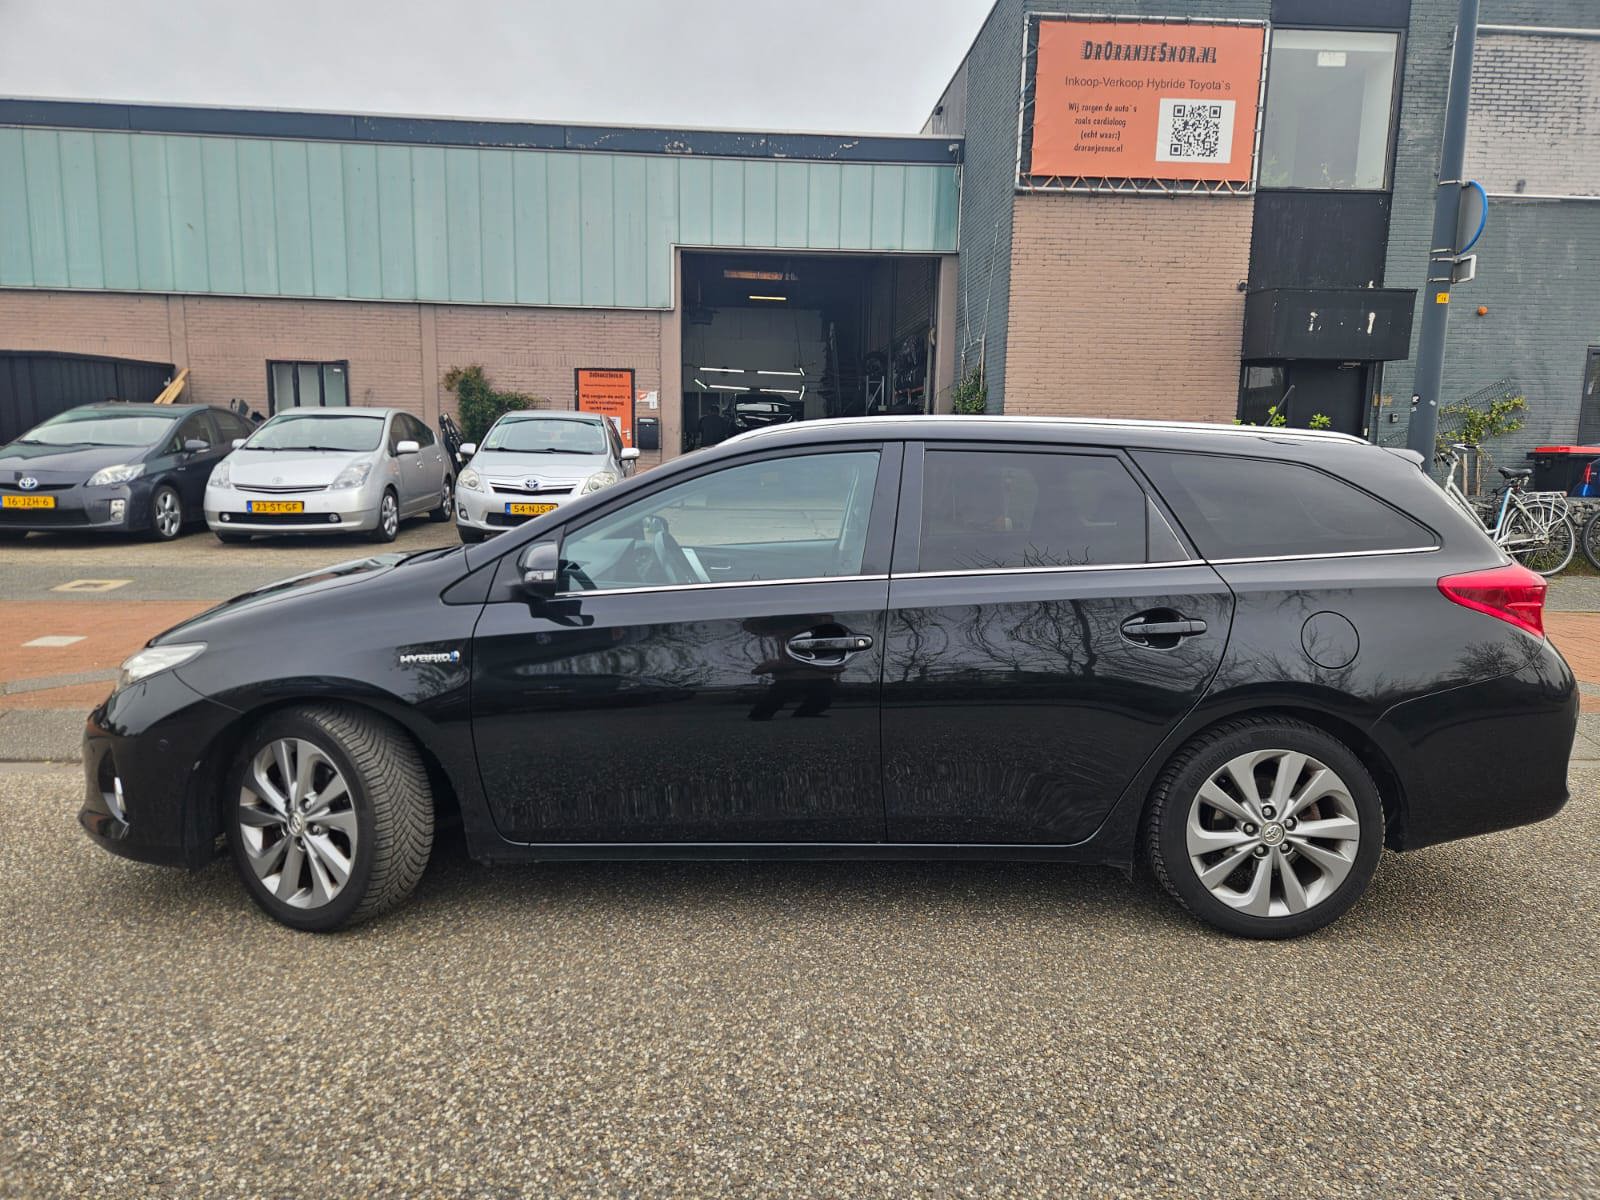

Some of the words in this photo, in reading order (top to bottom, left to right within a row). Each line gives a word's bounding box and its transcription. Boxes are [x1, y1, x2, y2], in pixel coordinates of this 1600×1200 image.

[1065, 76, 1143, 90] Inkoop-Verkoop
[1147, 79, 1185, 91] Hybride
[1068, 102, 1079, 113] Wij
[1081, 104, 1103, 113] zorgen
[1105, 103, 1112, 112] de
[1074, 116, 1091, 125] zoals
[1093, 116, 1126, 128] cardioloog
[1080, 130, 1097, 140] (echt
[1073, 143, 1123, 154] droranjesnor.nl
[7, 497, 49, 506] 16-JZH-6
[255, 503, 297, 512] 23-ST-GF
[400, 653, 451, 663] HYBRID
